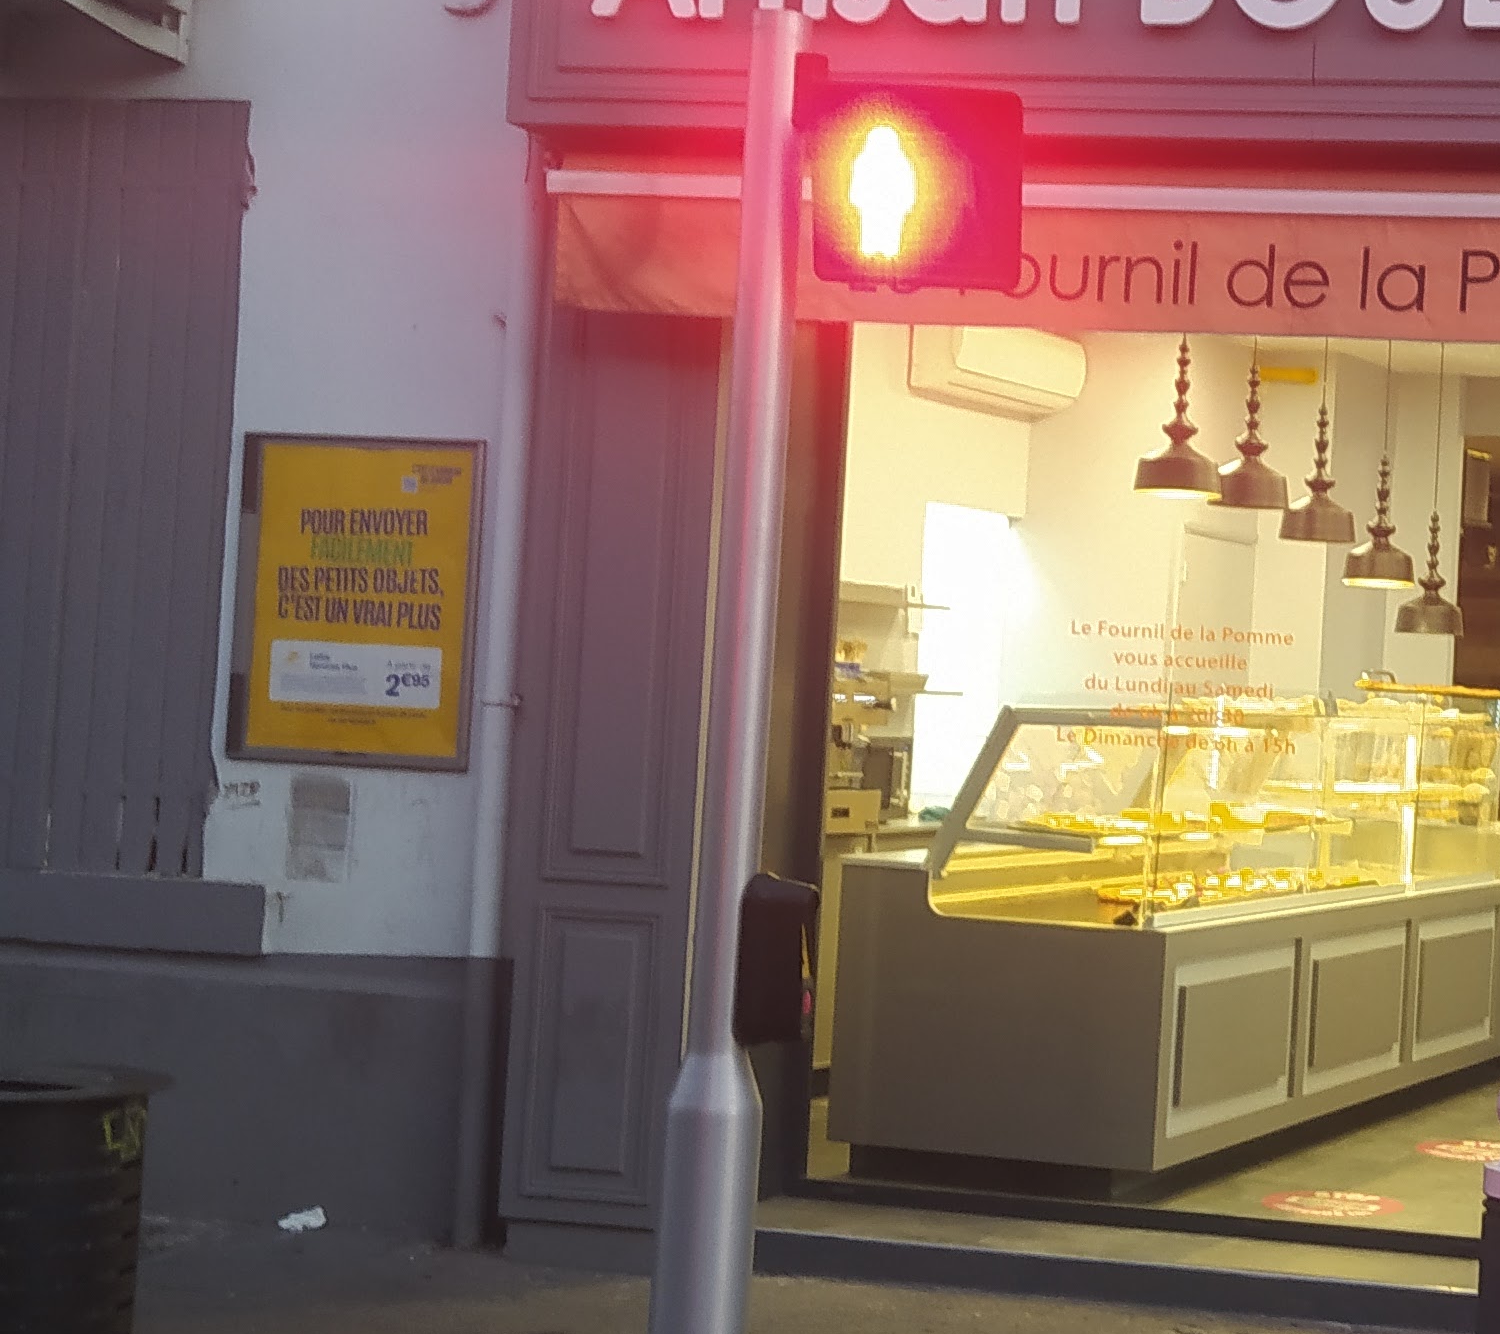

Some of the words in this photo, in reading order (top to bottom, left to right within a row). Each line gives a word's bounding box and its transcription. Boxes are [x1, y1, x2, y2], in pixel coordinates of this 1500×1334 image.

[962, 239, 1200, 306] ournil
[1226, 243, 1331, 310] de
[1358, 245, 1426, 313] la
[300, 508, 345, 534] POUR
[349, 509, 428, 536] ENVOYER
[277, 565, 310, 593] DES
[314, 567, 369, 594] PETITS
[373, 568, 444, 598] OBJETS,
[277, 592, 322, 622] C'EST
[324, 597, 349, 624] UN
[352, 598, 393, 628] VRAI
[396, 602, 443, 631] PLUS
[1071, 619, 1092, 636] Le
[1098, 619, 1165, 640] Fournil
[1170, 623, 1194, 641] de
[1200, 624, 1216, 642] la
[1222, 626, 1295, 647] Pomme
[1113, 651, 1158, 667] vous
[1163, 653, 1248, 671] accueille
[1084, 673, 1109, 691] du
[1115, 675, 1169, 694] Lundi
[1174, 681, 1197, 695] au
[1203, 681, 1275, 699] Samedi
[1056, 725, 1077, 743] Le
[1083, 727, 1180, 749] Dimanche
[1185, 732, 1209, 751] de
[1263, 737, 1296, 755] 15h
